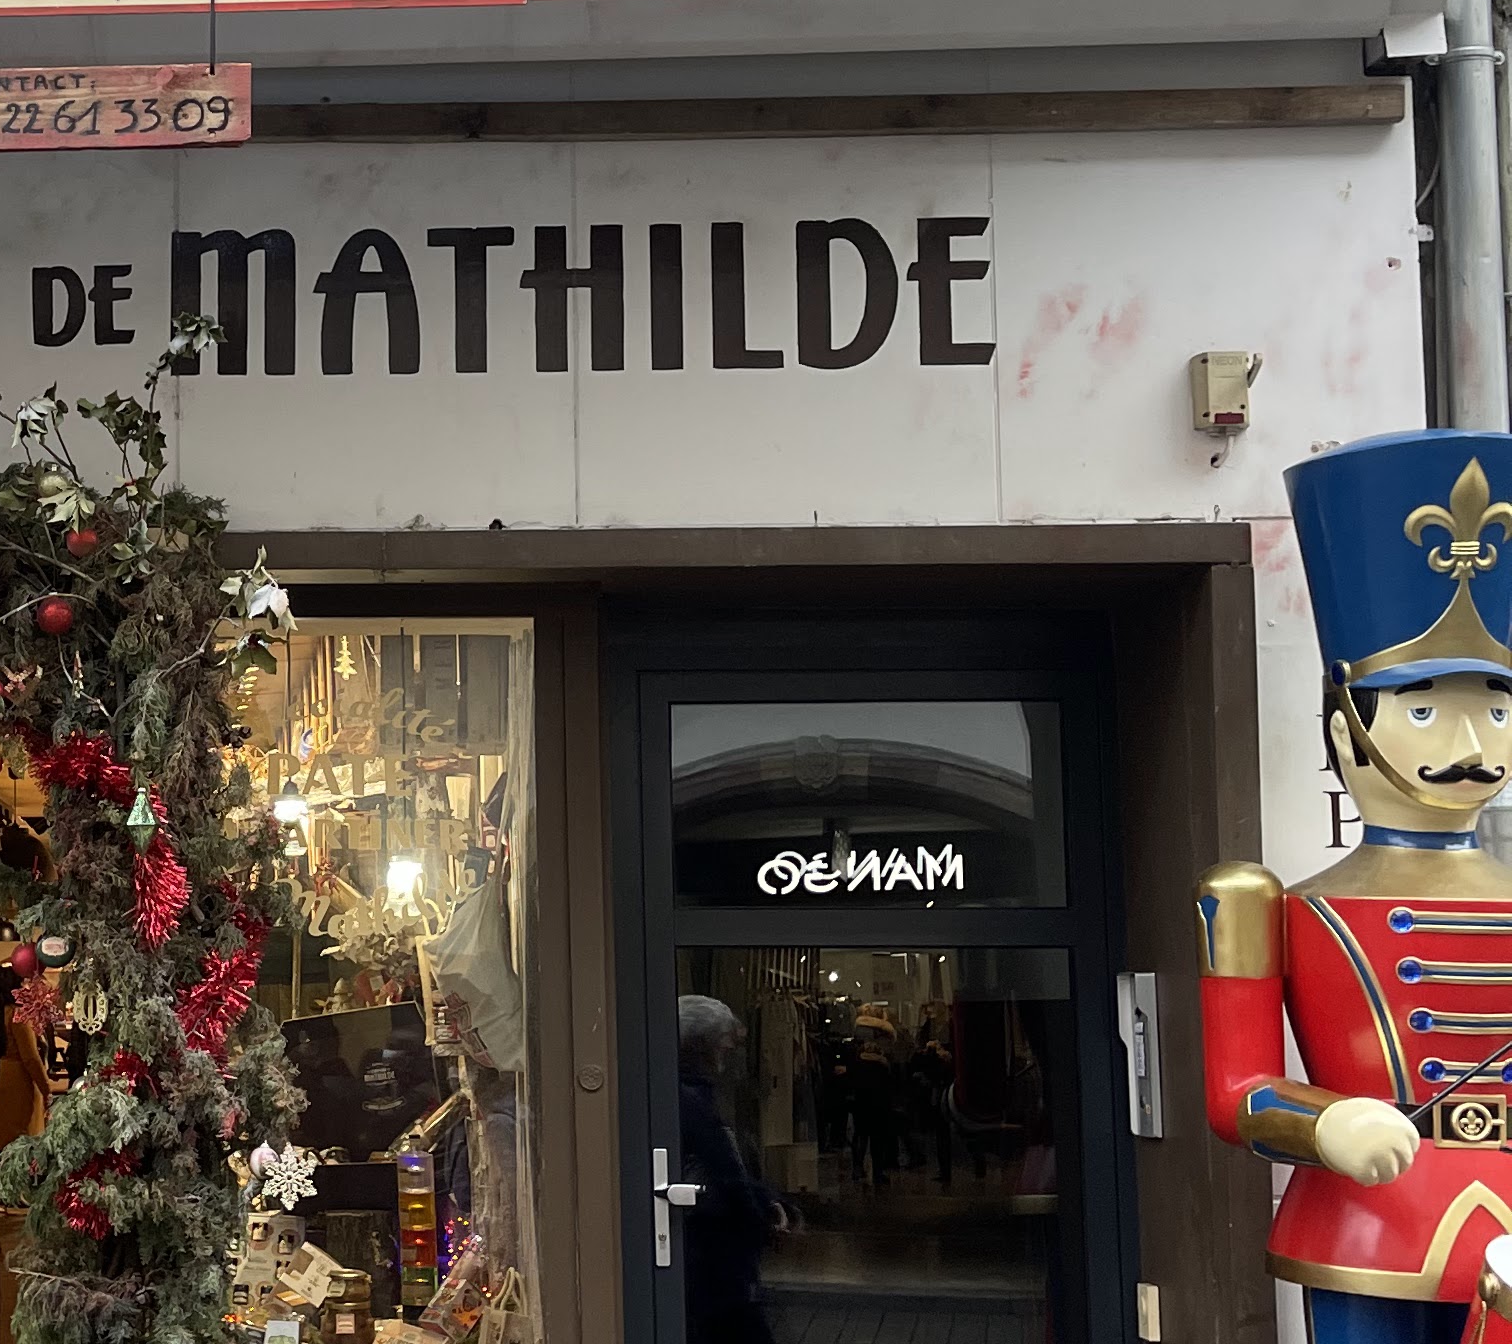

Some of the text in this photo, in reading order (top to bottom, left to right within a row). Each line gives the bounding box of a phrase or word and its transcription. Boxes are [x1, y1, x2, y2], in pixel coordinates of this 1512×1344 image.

[2, 102, 44, 134] 22
[53, 100, 103, 135] 61
[114, 99, 163, 133] 33
[172, 95, 232, 133] 09
[31, 263, 135, 348] DE
[170, 217, 997, 377] MATHILDE
